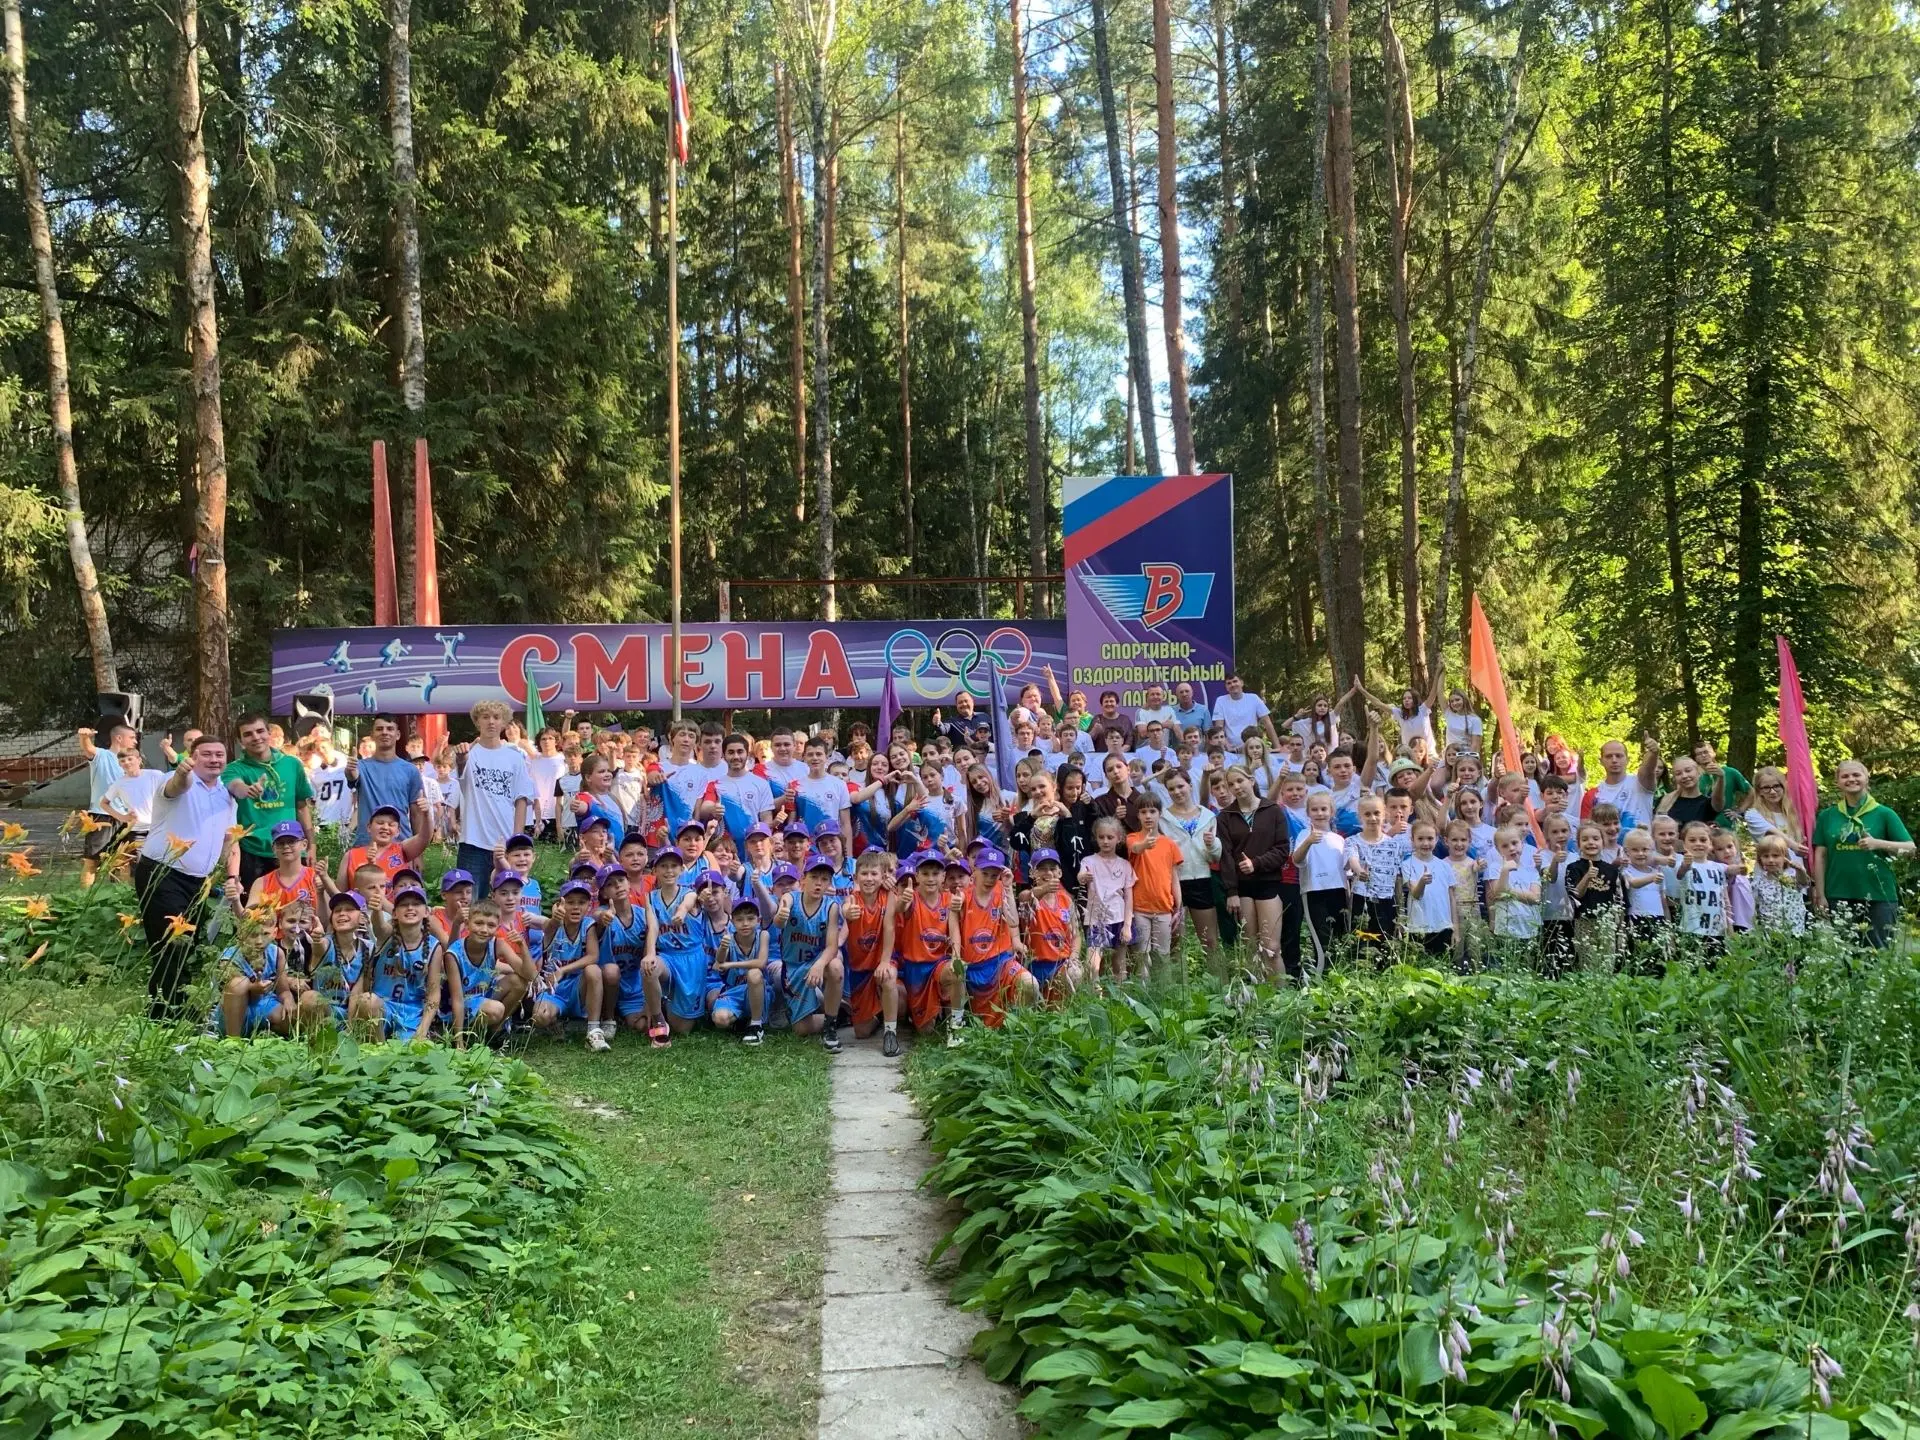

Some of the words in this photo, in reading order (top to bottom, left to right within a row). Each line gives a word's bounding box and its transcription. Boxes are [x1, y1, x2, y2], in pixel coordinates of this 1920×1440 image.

[1101, 641, 1197, 660] СПОРТИВНО-
[499, 629, 860, 707] СМЕНА
[1073, 661, 1226, 686] ОЗДОРОВИТЕЛЬНЫЙ
[1122, 689, 1178, 707] ЛАГРЬ
[320, 780, 344, 801] 07
[281, 823, 290, 831] 21
[1836, 843, 1862, 851] Смен
[790, 932, 820, 947] КАЛУГ
